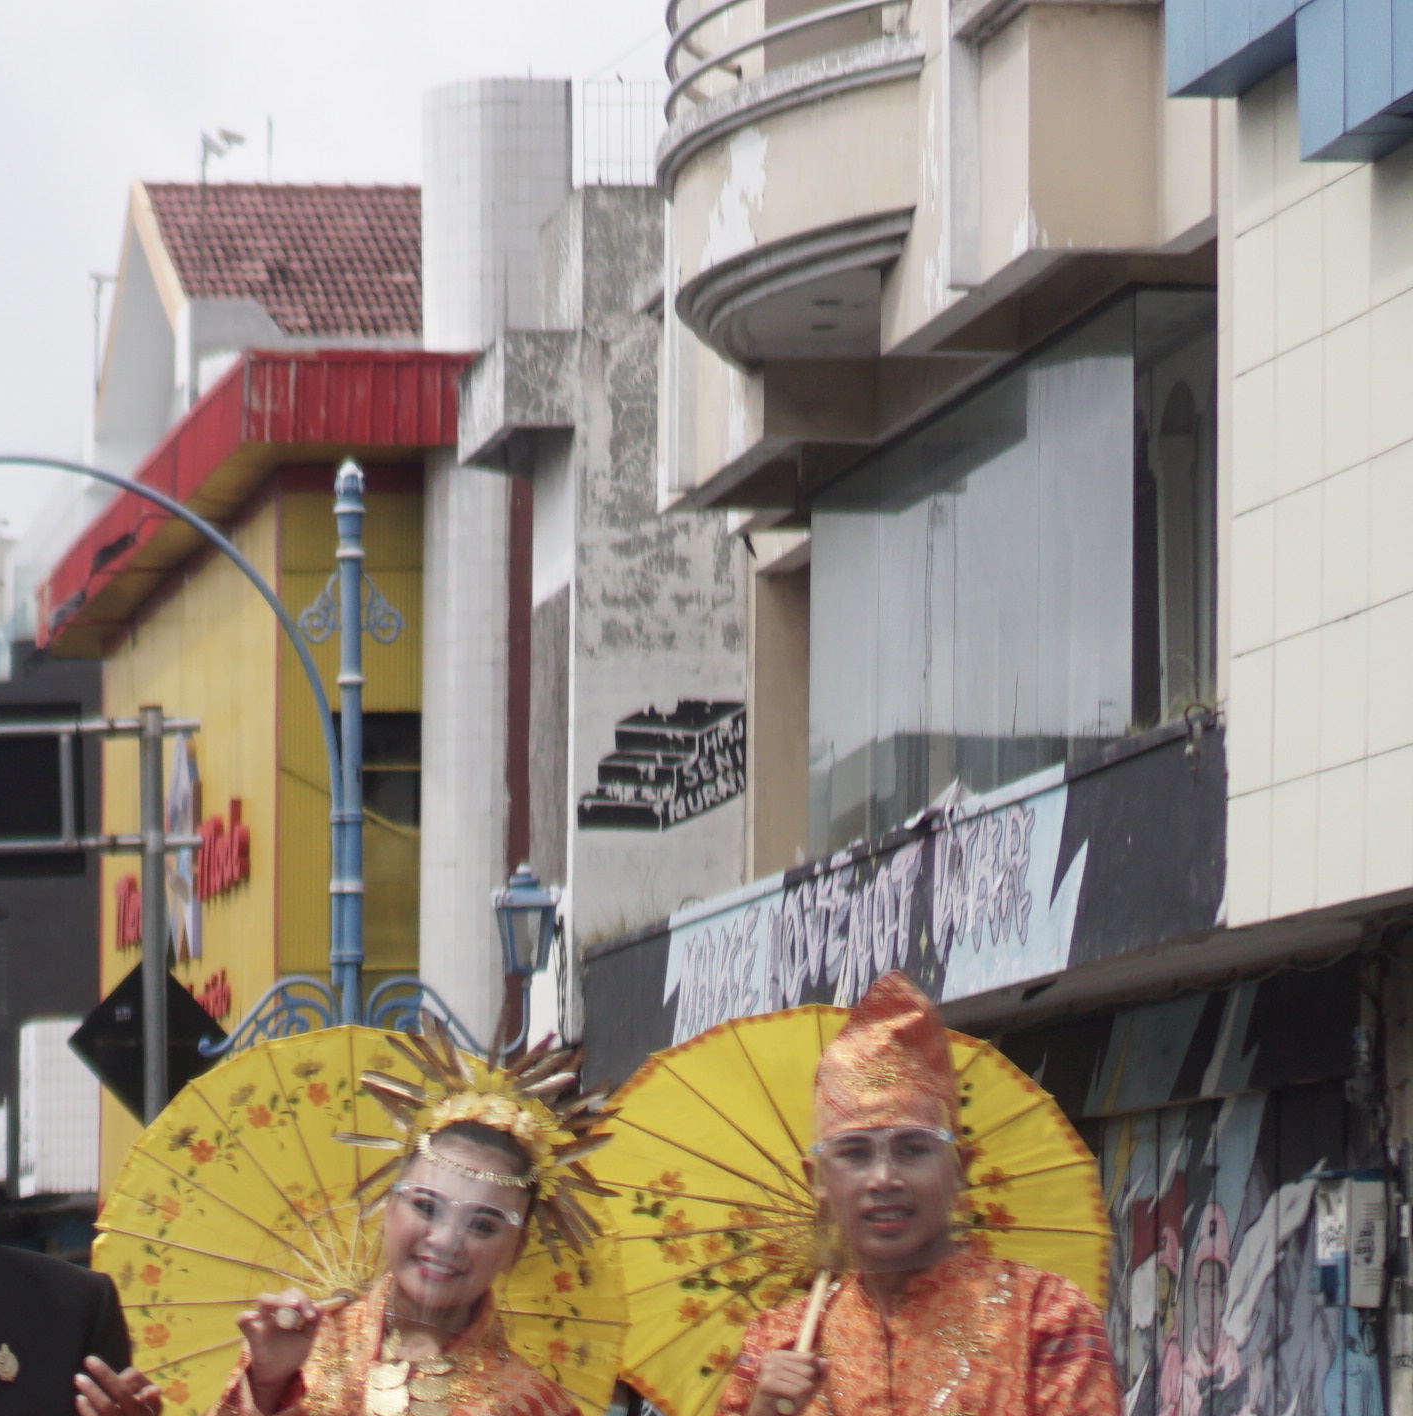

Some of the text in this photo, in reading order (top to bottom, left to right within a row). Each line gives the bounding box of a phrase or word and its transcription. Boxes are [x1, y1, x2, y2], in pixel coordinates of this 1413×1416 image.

[682, 745, 745, 787] SENI
[668, 769, 746, 824] MURNI
[675, 803, 1036, 1046] MAKE LOVE NOT WAR
